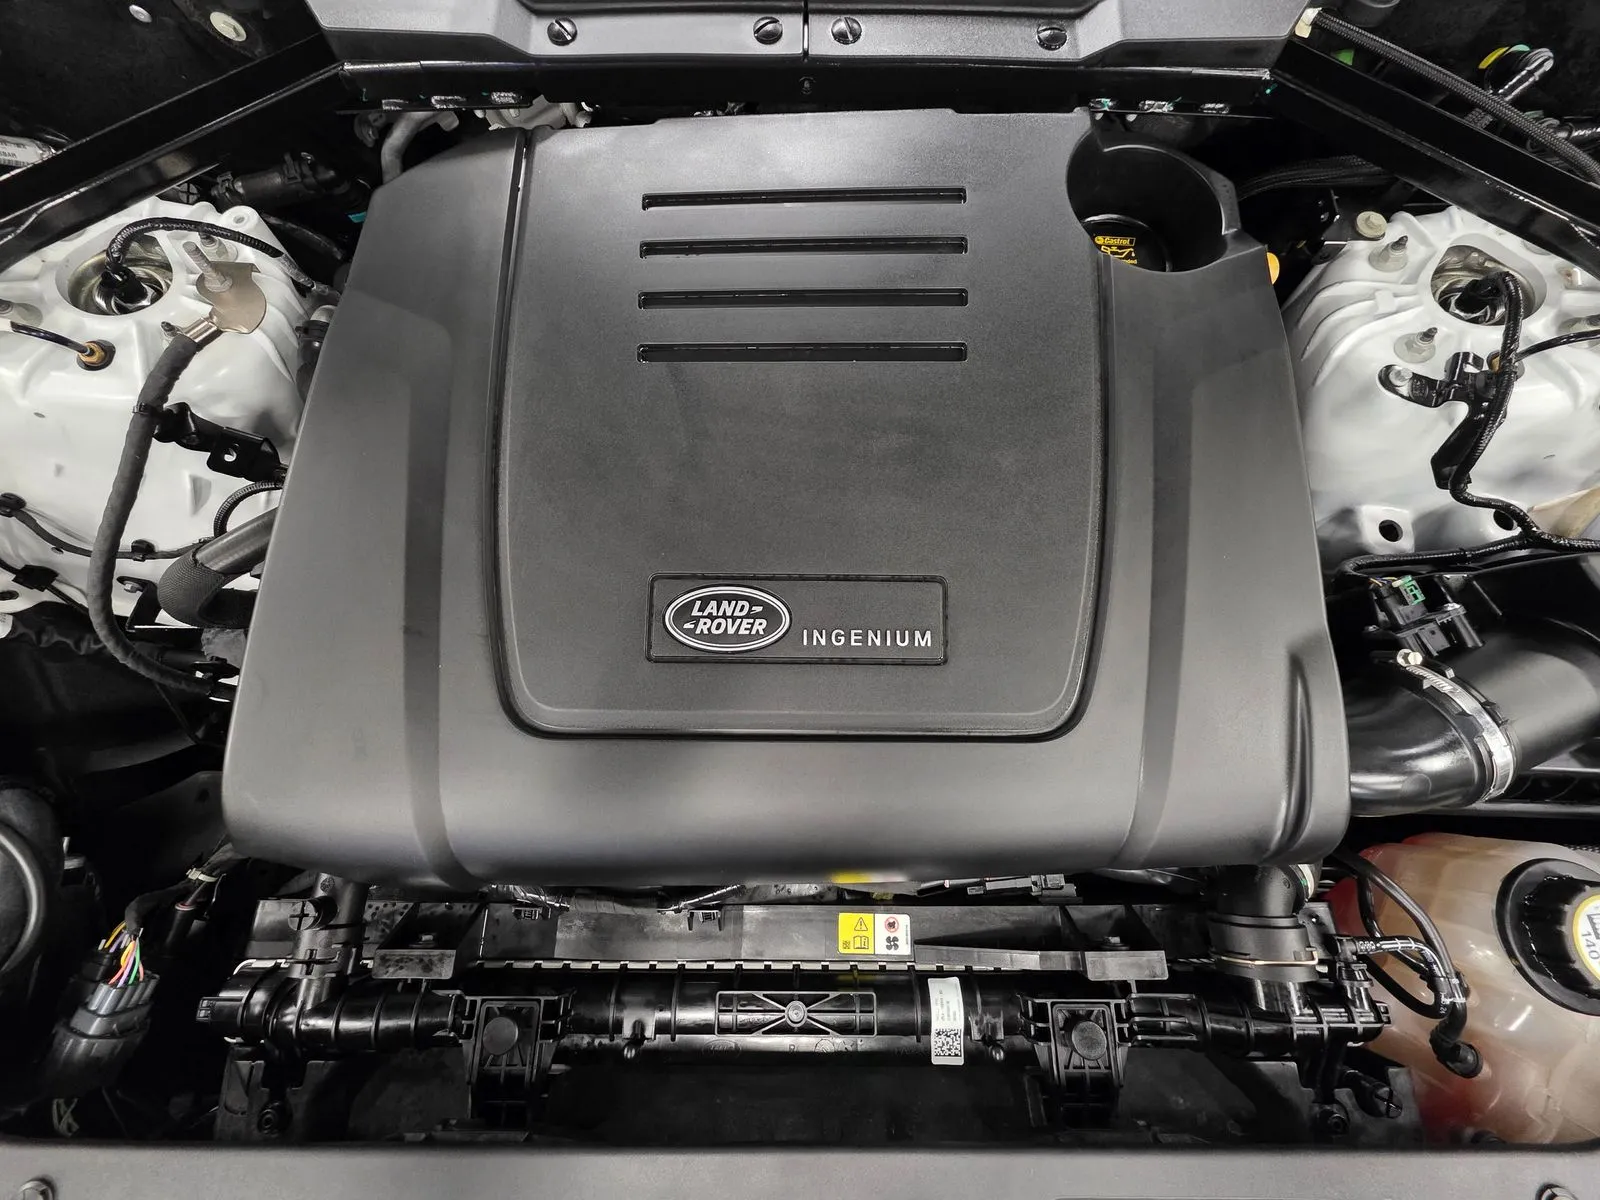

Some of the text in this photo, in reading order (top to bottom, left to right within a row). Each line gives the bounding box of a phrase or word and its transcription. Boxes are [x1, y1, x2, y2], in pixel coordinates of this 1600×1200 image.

[1104, 237, 1130, 245] Castrol
[691, 600, 751, 617] LAND
[694, 618, 768, 635] ROVER
[802, 629, 932, 647] INGENIUM
[1581, 931, 1600, 960] 140
